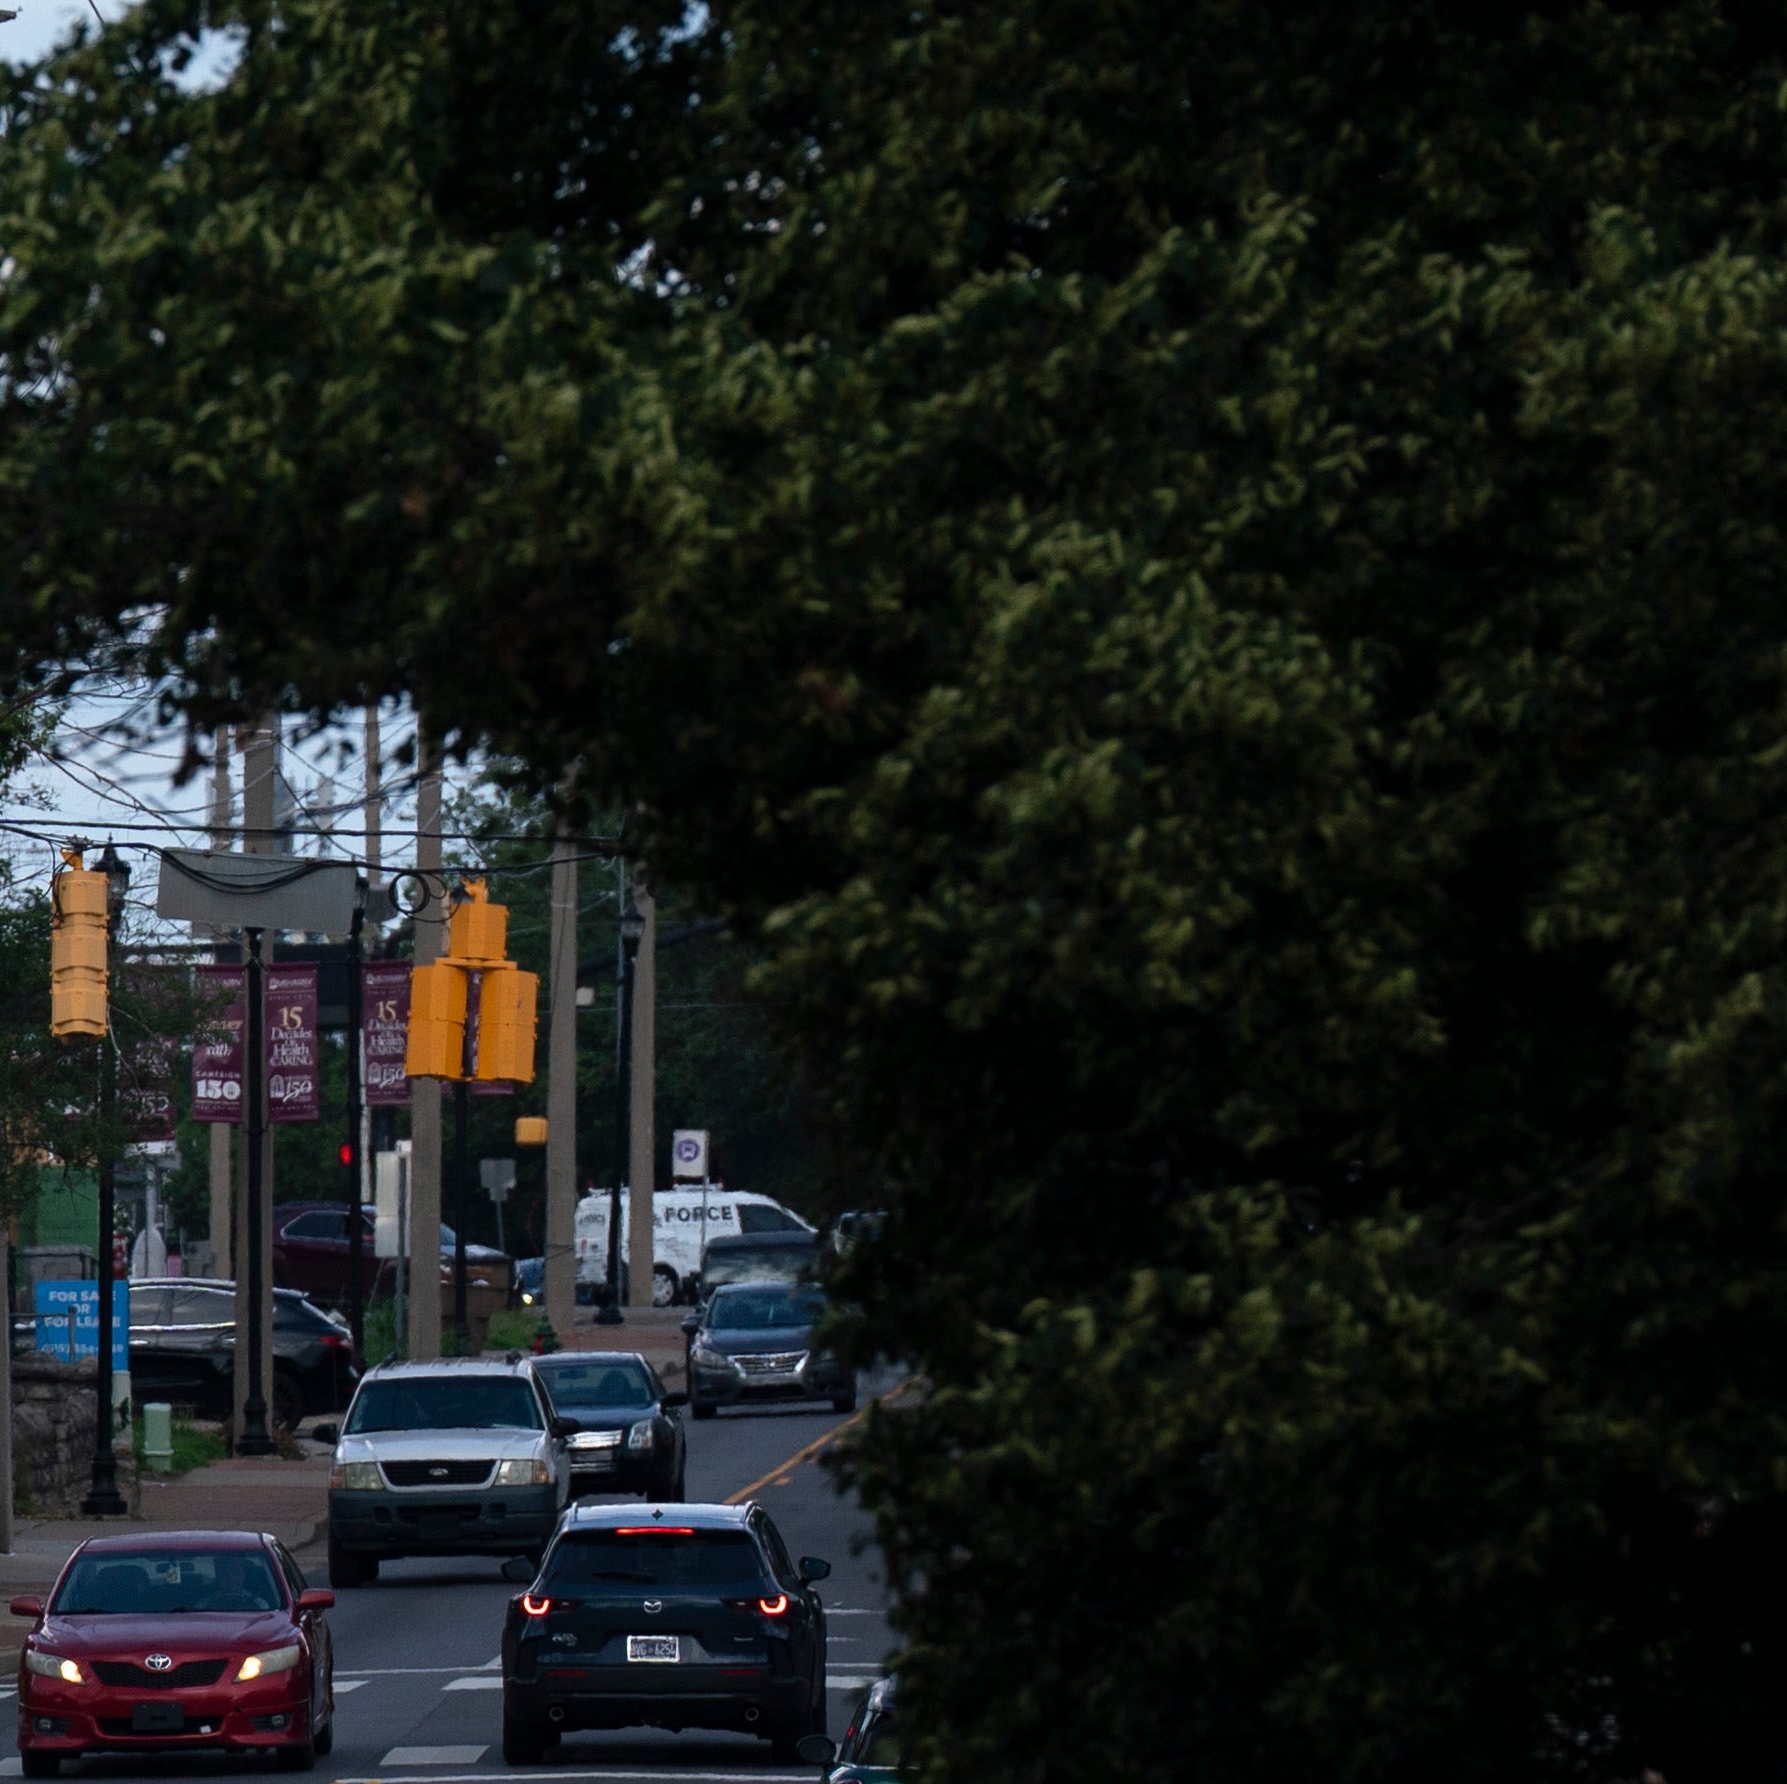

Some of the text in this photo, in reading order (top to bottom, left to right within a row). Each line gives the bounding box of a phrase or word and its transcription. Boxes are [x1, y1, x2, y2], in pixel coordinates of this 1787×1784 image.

[279, 1006, 303, 1030] 15
[377, 1000, 397, 1023] 15
[196, 1079, 241, 1100] 150
[665, 1205, 733, 1223] FORCE
[48, 1290, 117, 1302] FOR SAE
[76, 1316, 121, 1328] LEAE
